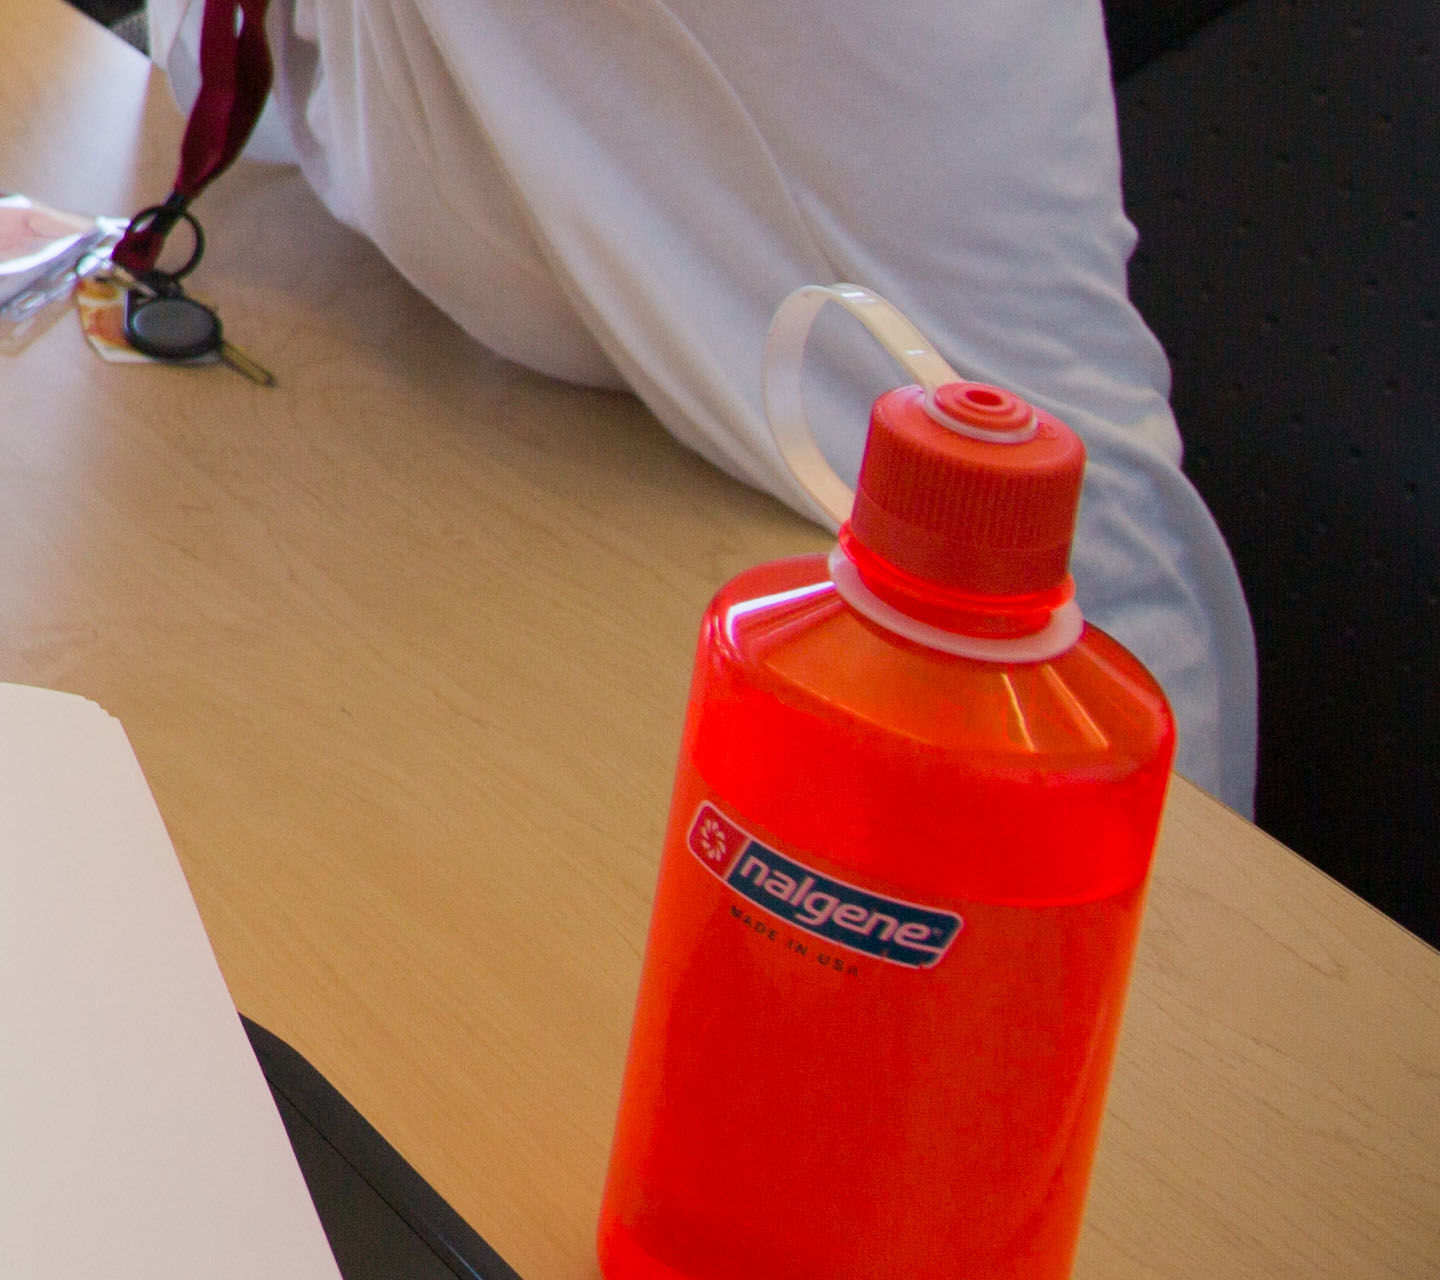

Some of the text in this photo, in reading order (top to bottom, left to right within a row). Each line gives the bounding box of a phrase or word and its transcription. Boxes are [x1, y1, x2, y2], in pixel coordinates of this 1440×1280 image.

[729, 904, 860, 977] MADE IN USA
[739, 854, 942, 954] nalgene
